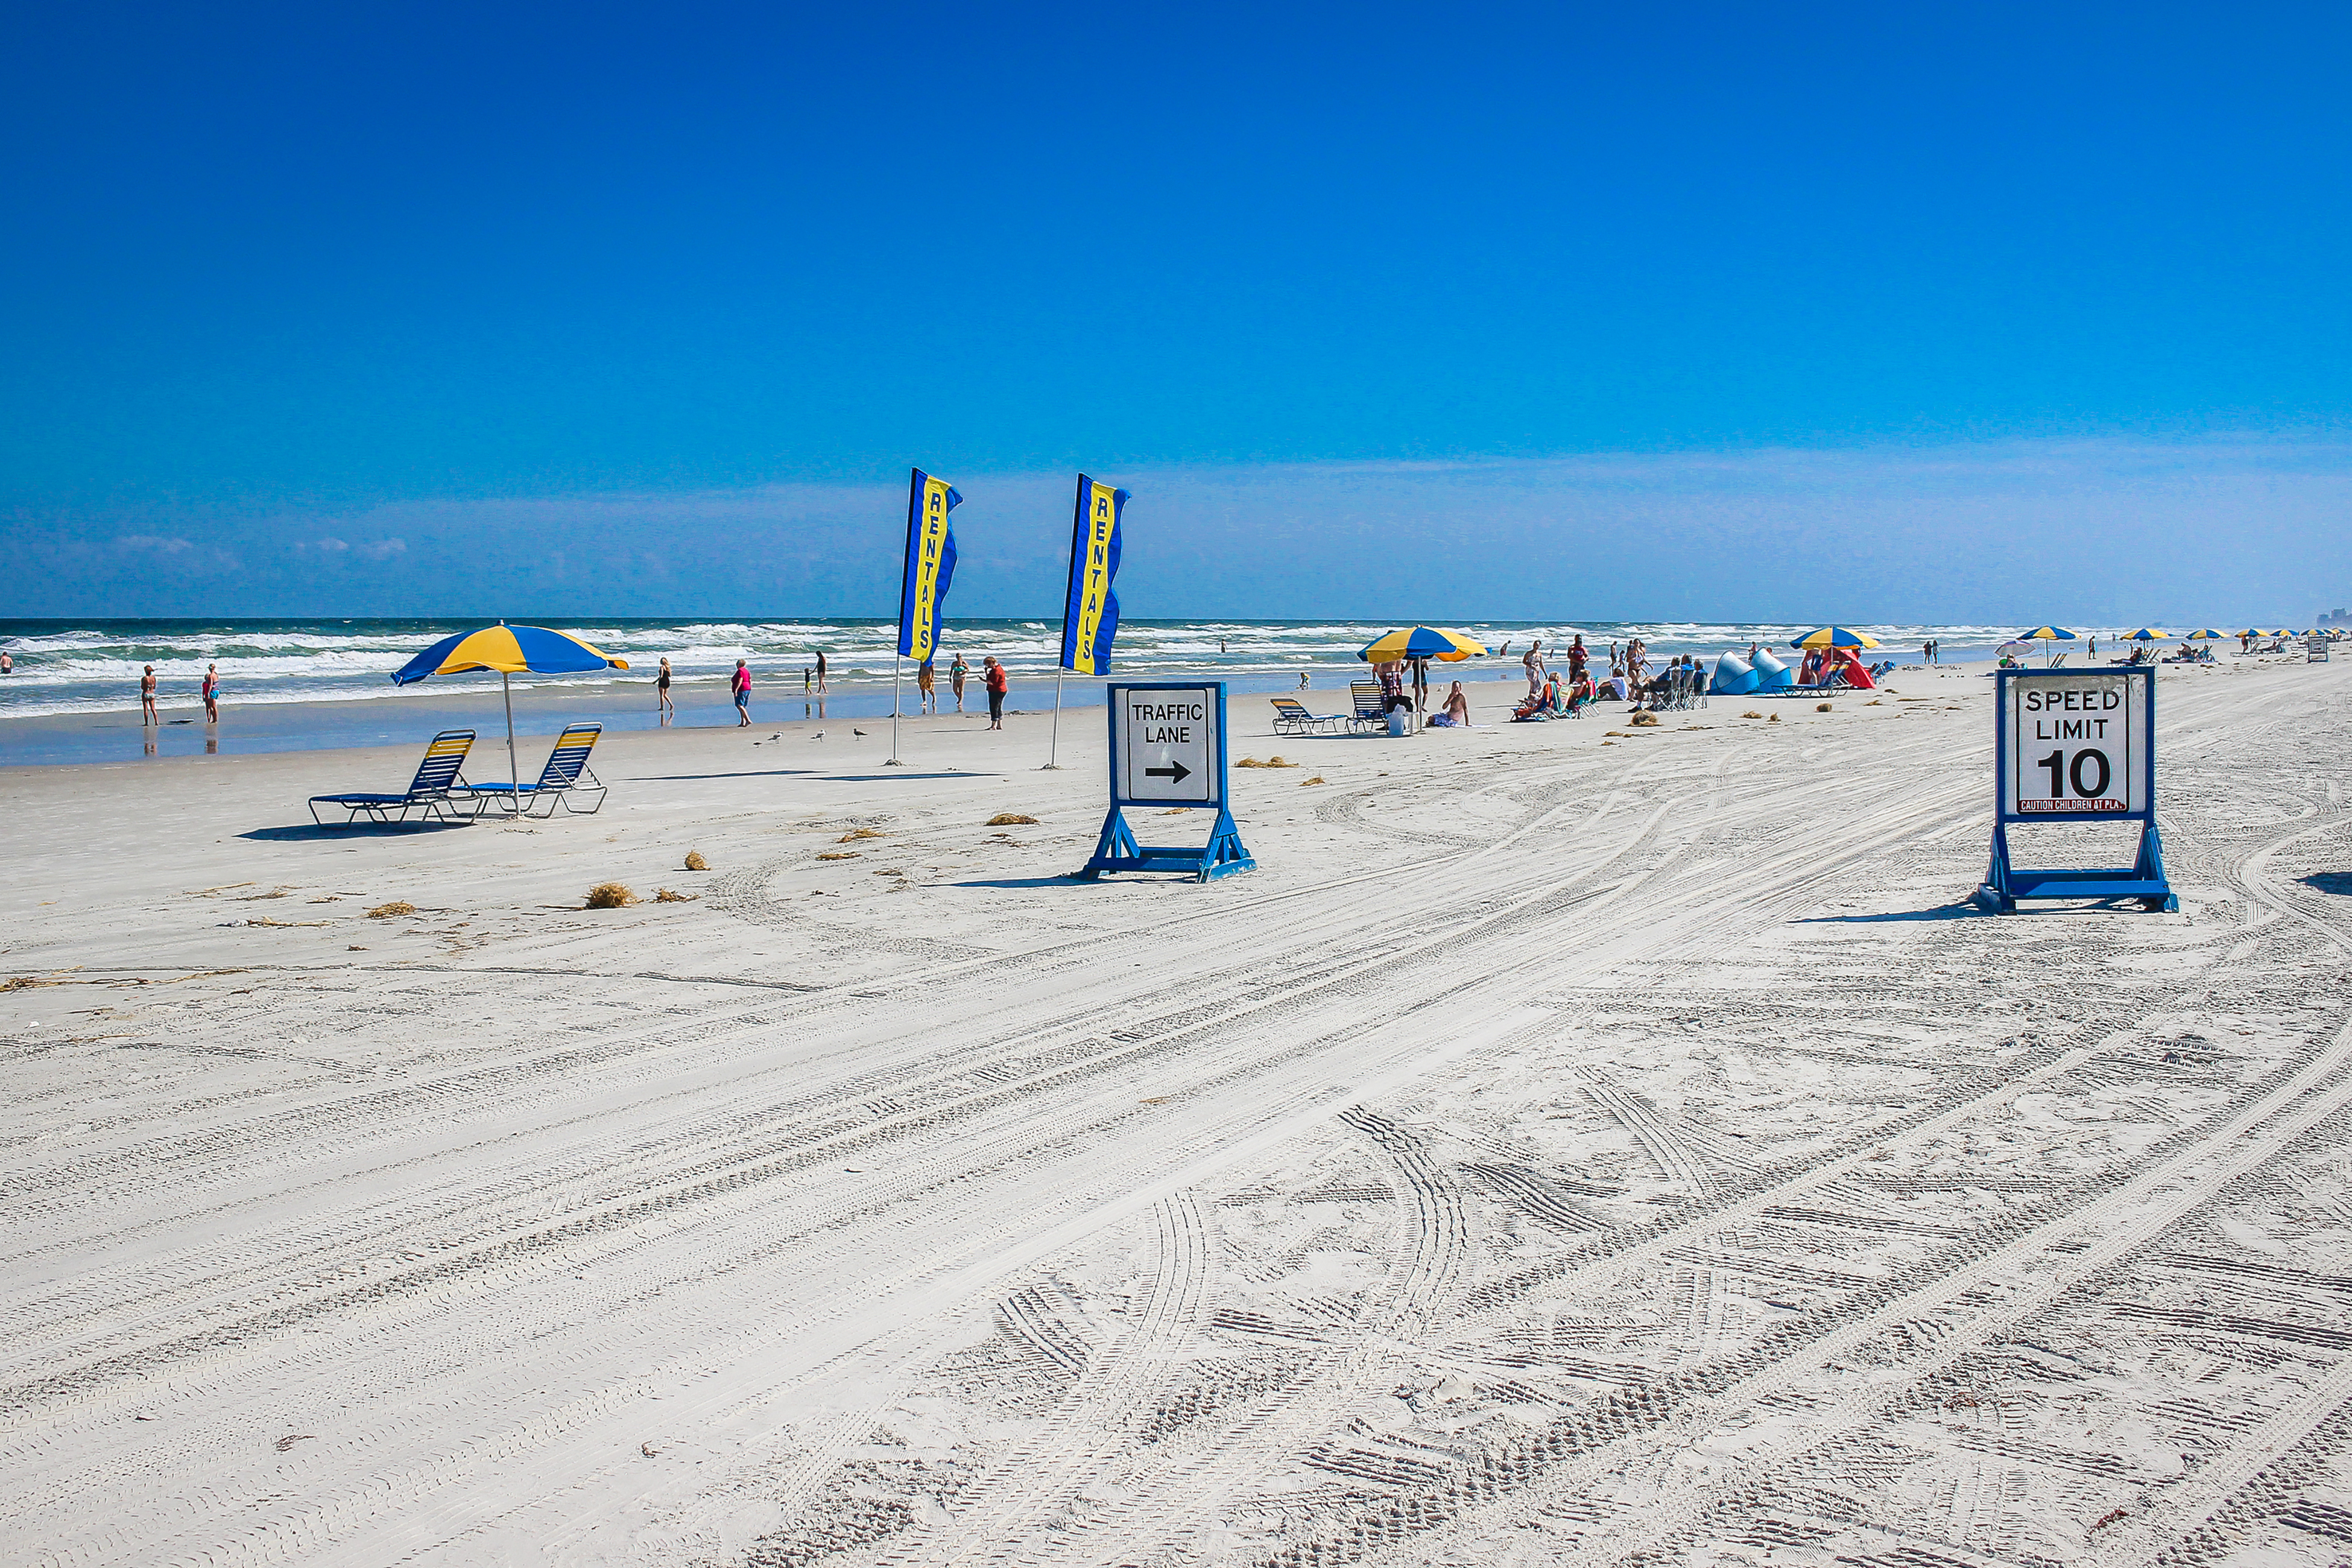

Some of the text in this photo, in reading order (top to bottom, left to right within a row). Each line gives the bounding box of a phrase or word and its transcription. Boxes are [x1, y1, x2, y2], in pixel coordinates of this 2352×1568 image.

[920, 493, 941, 649] RENTALS
[1083, 498, 1108, 660] RENTALS
[2025, 690, 2120, 711] SPEED
[1132, 704, 1203, 721] TRAFFIC
[1145, 727, 1190, 743] LANE
[2036, 719, 2108, 740] LIMIT
[2037, 748, 2111, 798] 10
[2021, 800, 2053, 810] CAUTION
[2055, 800, 2091, 809] CHILDREN
[2105, 800, 2122, 809] PLA
